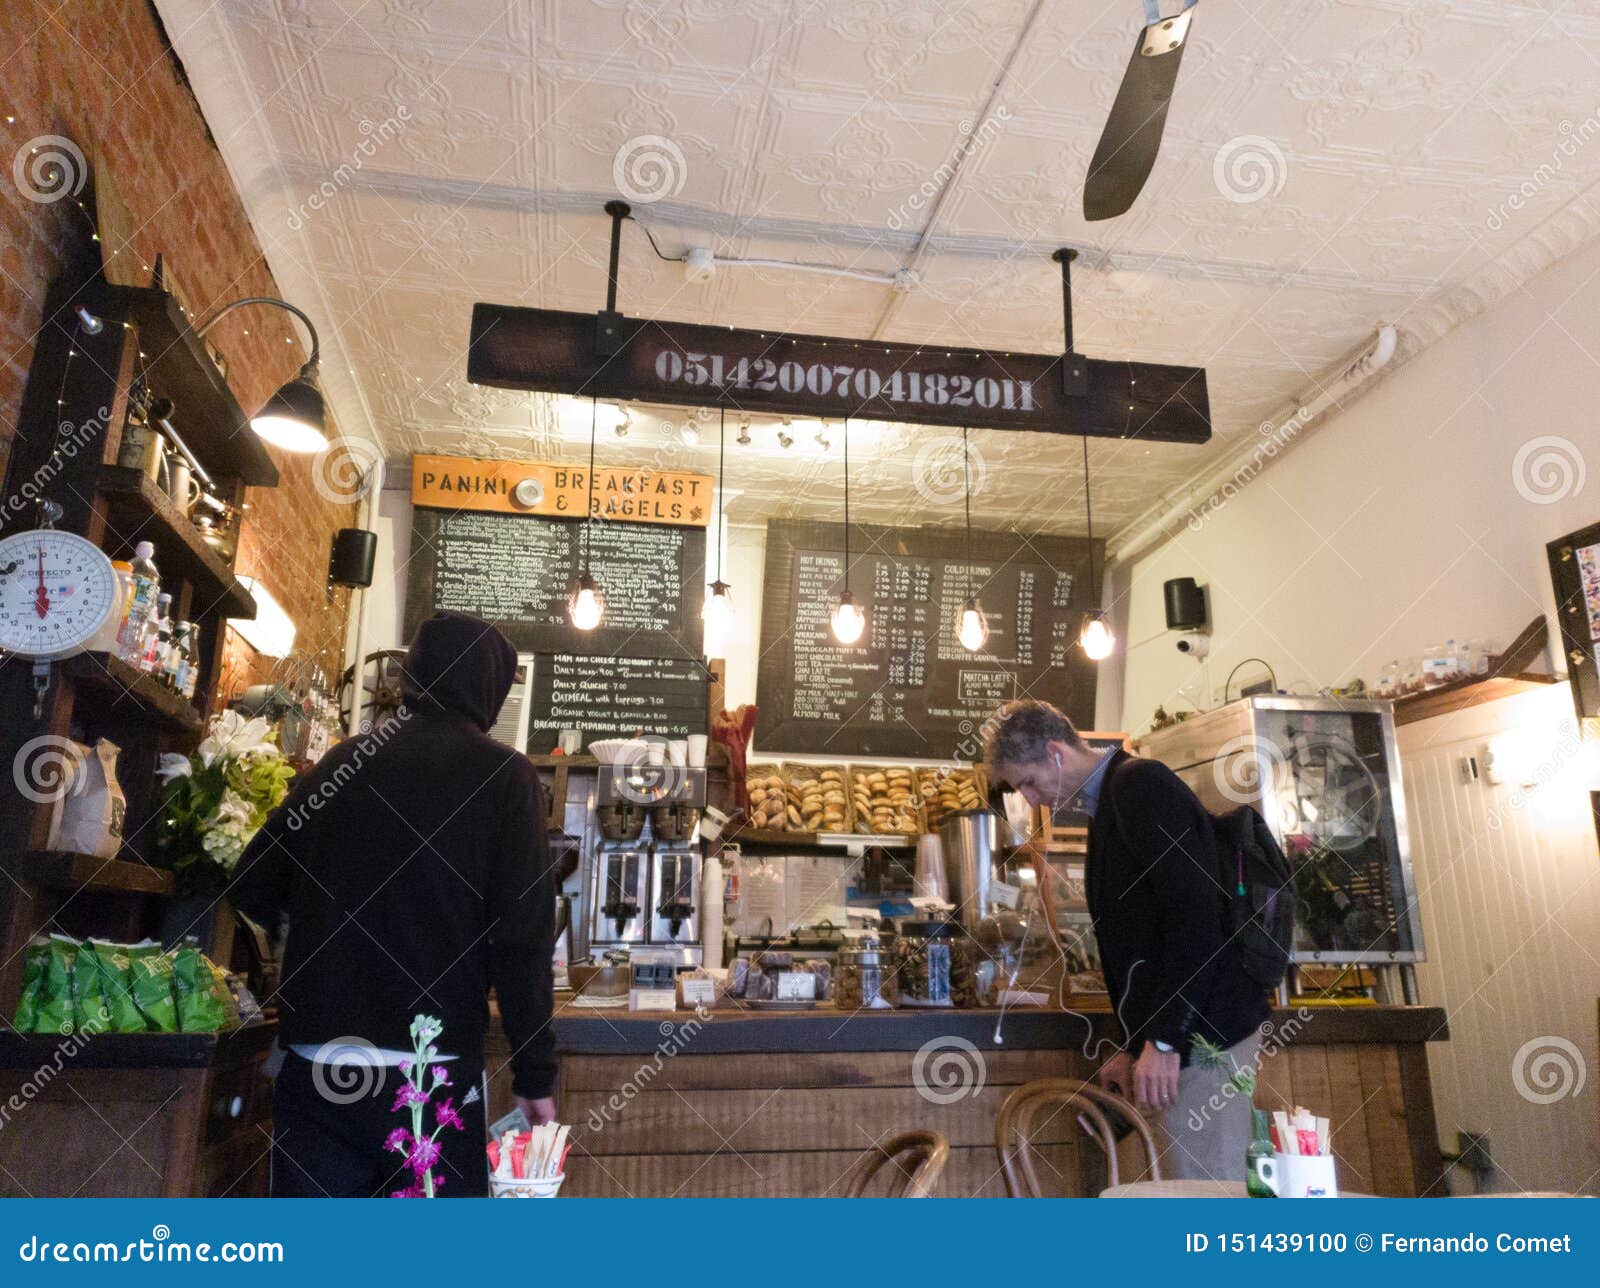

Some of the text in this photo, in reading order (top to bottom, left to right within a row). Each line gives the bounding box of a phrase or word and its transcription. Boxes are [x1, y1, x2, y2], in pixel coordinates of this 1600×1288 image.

[422, 472, 507, 495] PANINI
[555, 471, 701, 497] BREAKFAST
[589, 498, 683, 519] BAGELS
[800, 556, 814, 565] HOT
[944, 564, 964, 574] COLD
[554, 655, 573, 663] HAM
[590, 656, 616, 665] CHEESE
[809, 654, 843, 662] CHOCOLATE
[554, 664, 575, 674] DAILY
[553, 679, 577, 690] DAILY
[580, 681, 609, 690] QUICHE
[551, 692, 593, 703] OATMEAL
[596, 695, 610, 703] with
[551, 707, 584, 717] ORGANIC
[793, 710, 840, 720] ALMOND MILK
[533, 720, 573, 729] BREAKFAST
